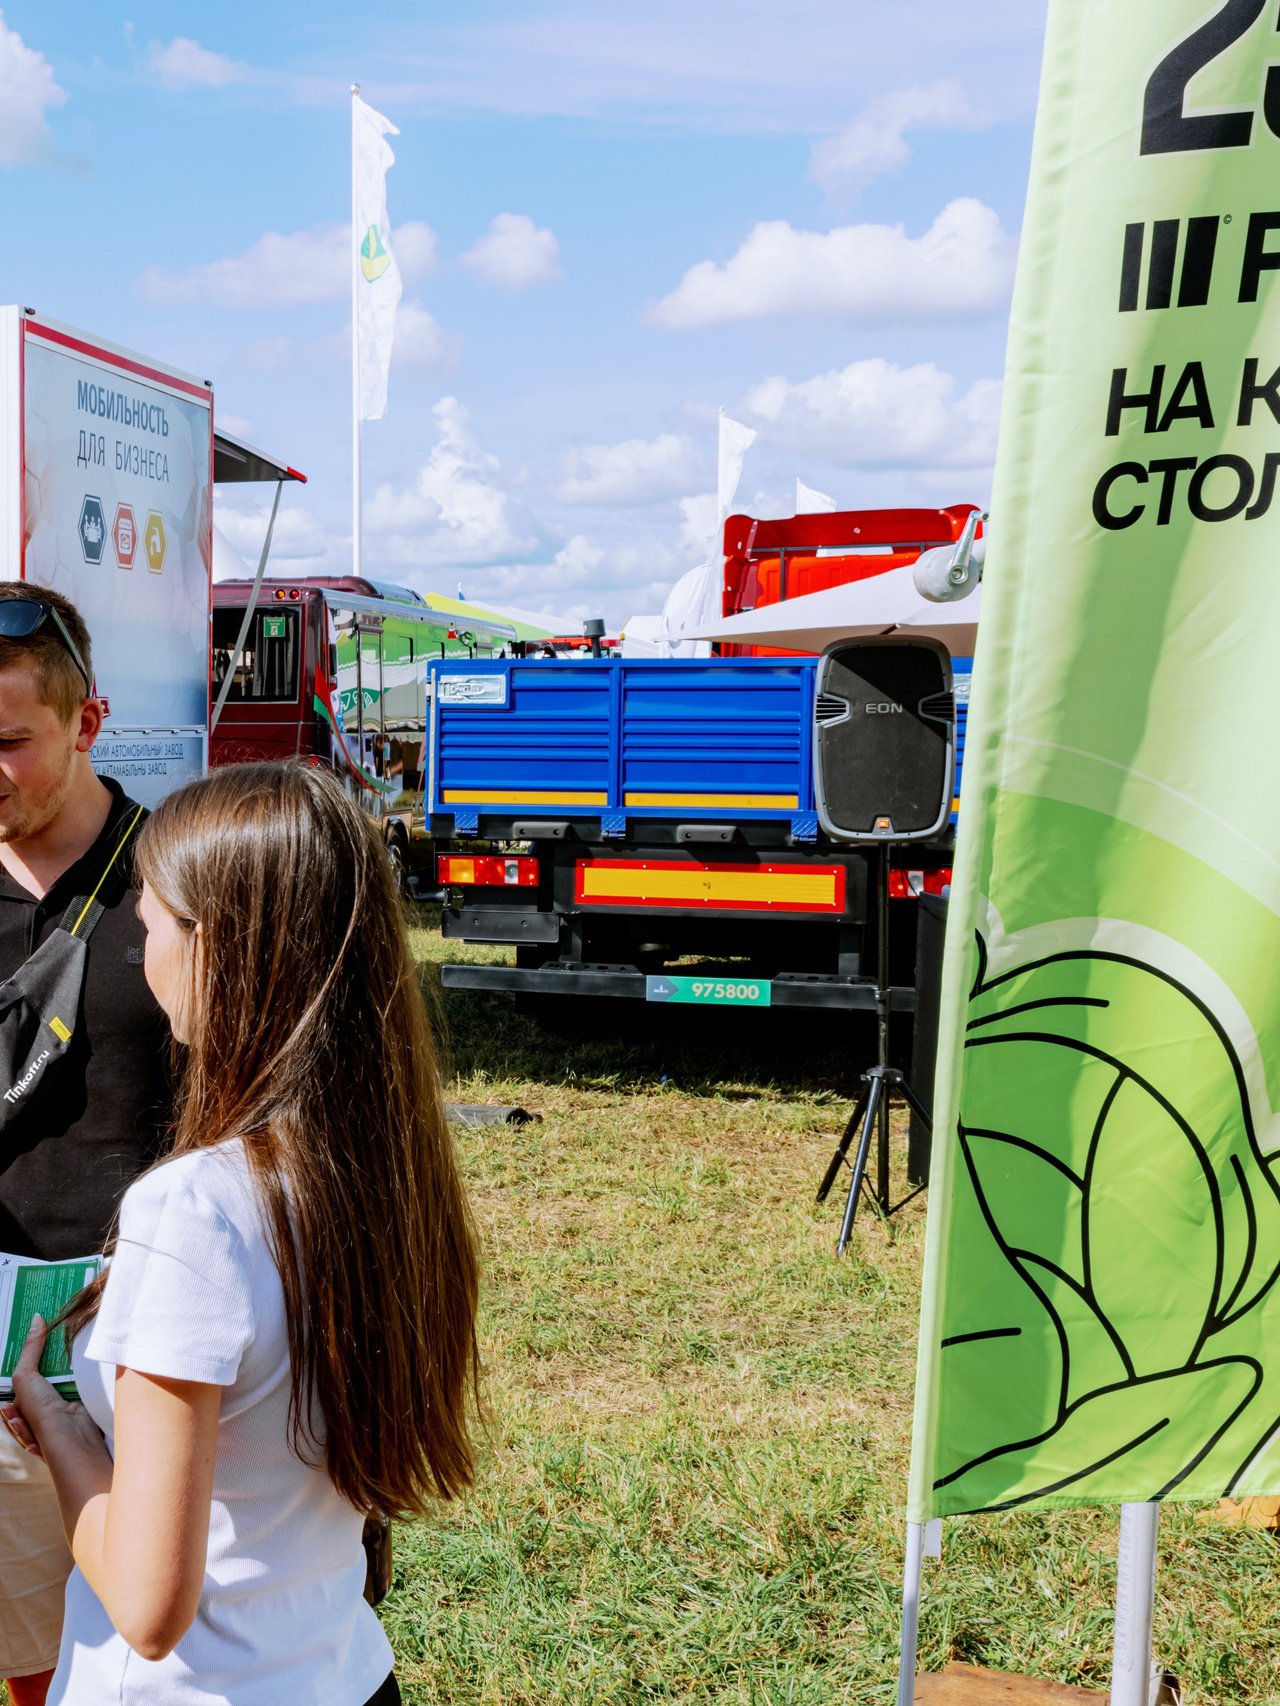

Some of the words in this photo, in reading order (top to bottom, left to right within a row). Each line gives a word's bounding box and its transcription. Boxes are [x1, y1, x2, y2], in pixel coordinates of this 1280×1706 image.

[1140, 0, 1280, 156] 2
[77, 379, 169, 437] МОБИЛЬНОСТЬ
[1105, 361, 1215, 437] НА
[77, 429, 106, 470] ДЛЯ
[115, 440, 169, 483] БИЗНЕСА
[865, 702, 903, 714] EON
[111, 742, 163, 758] АВТОМОБИЛЬНЫЙ
[164, 743, 184, 757] ЗАВОД
[147, 762, 167, 776] ЗАВОД
[692, 982, 760, 1000] 975800
[3, 1049, 50, 1104] Tinkoff.ru
